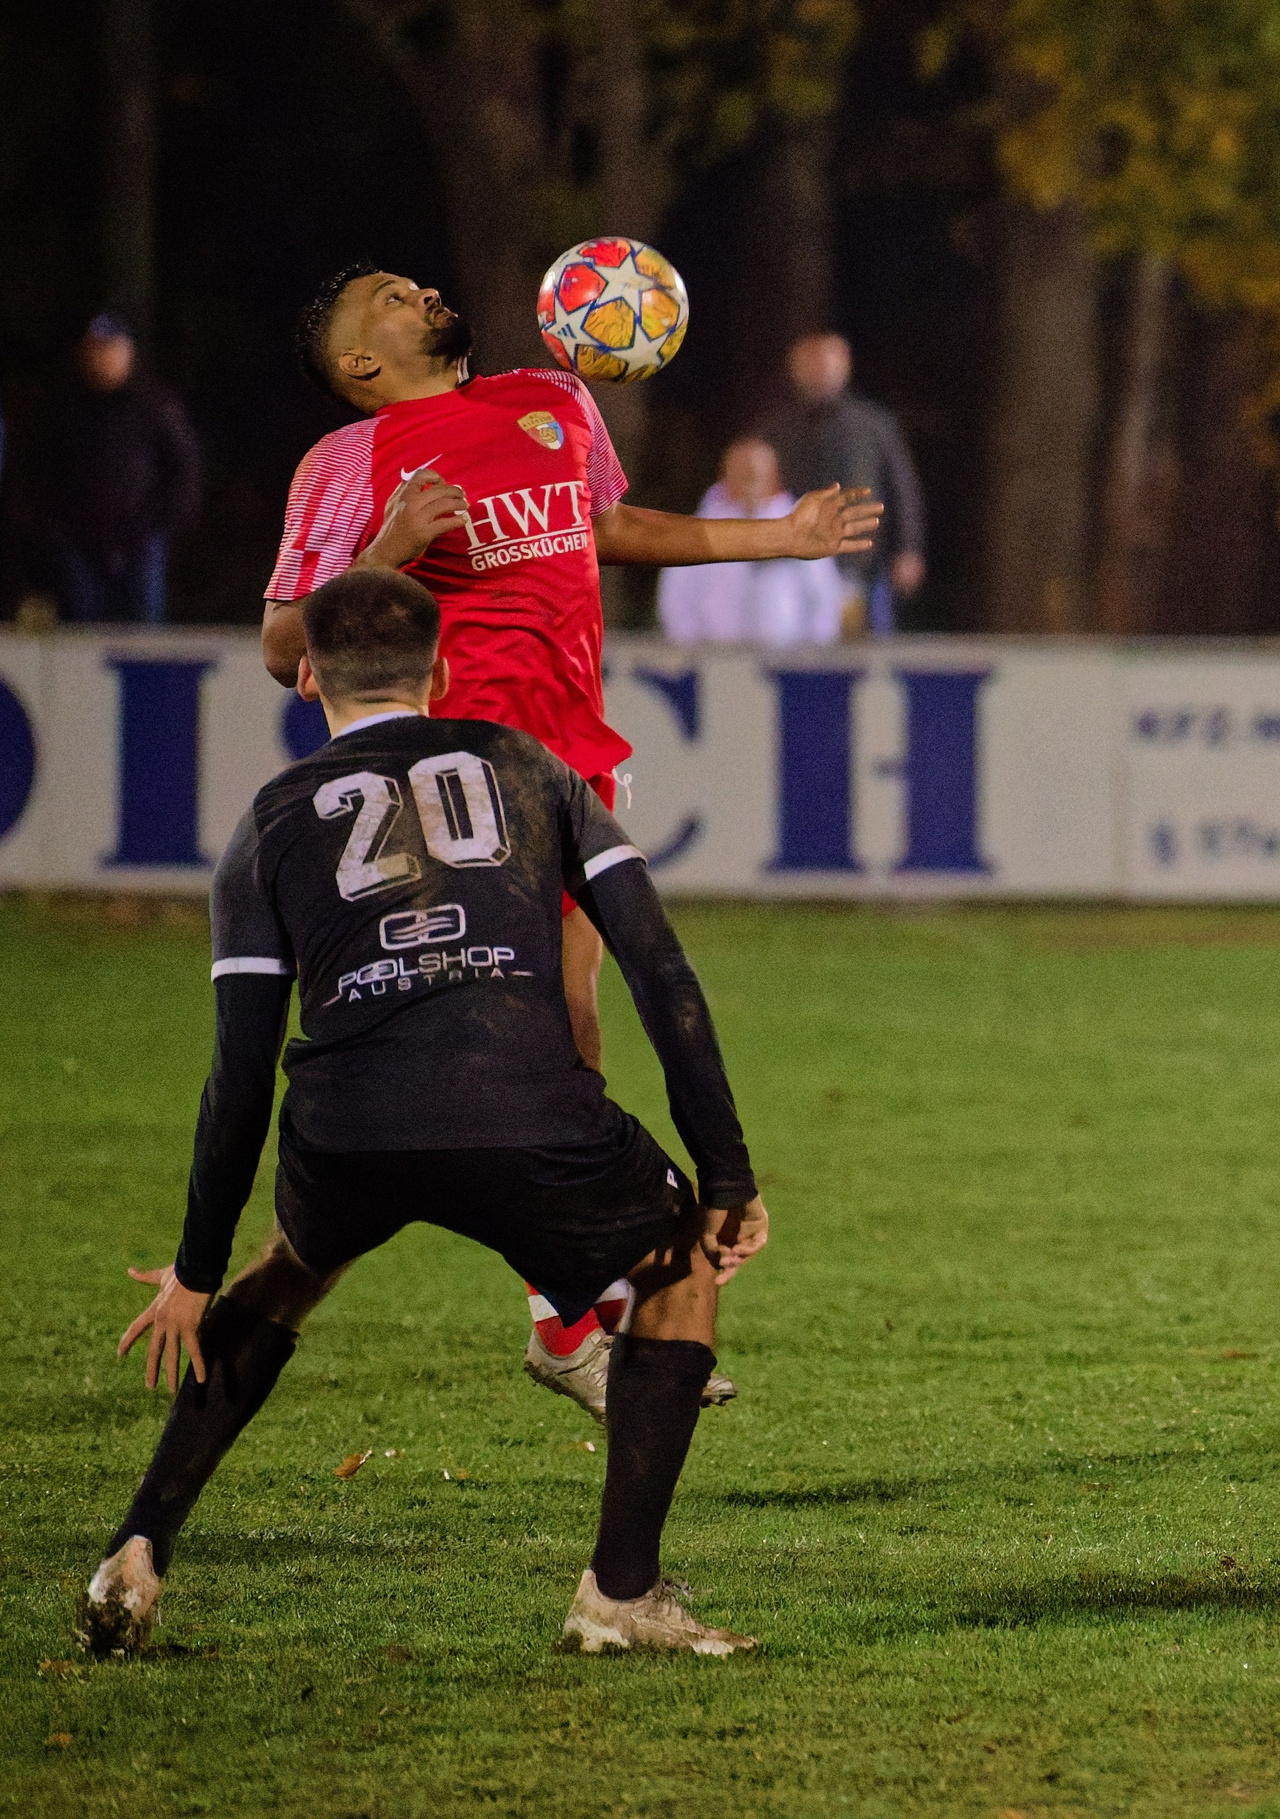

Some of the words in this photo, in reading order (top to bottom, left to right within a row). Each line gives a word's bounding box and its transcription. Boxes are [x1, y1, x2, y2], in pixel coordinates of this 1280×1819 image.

[465, 480, 584, 551] HWT
[471, 533, 588, 571] GROSSKÜCHEN
[313, 751, 512, 902] 20
[338, 946, 515, 995] POOLSHOP
